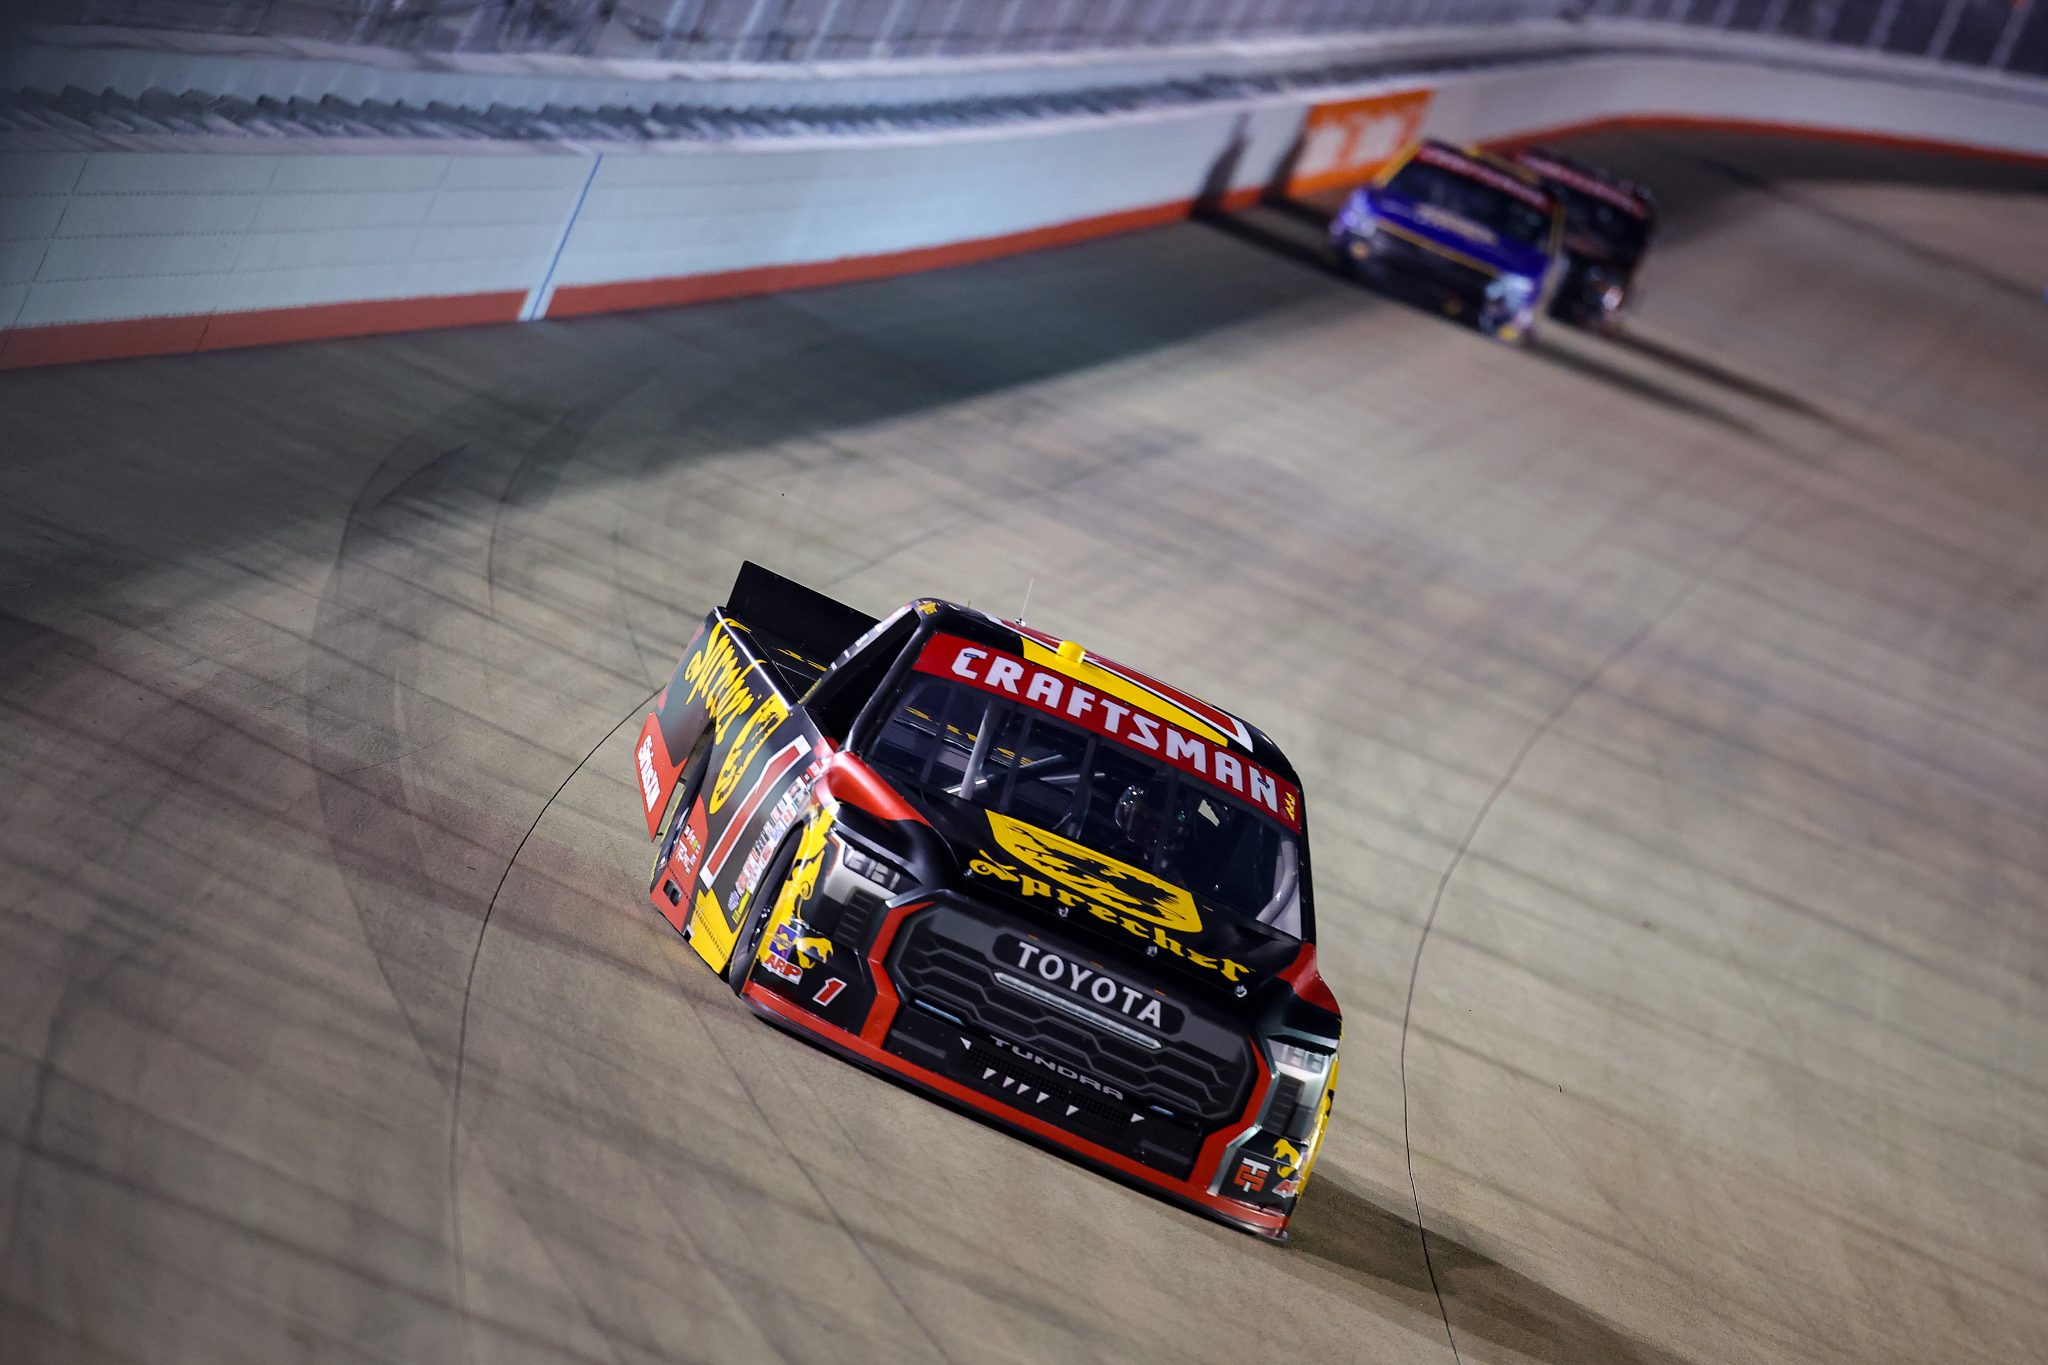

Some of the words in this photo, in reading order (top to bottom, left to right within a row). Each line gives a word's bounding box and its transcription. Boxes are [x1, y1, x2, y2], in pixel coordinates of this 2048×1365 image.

[951, 647, 1279, 813] CRAFTSMAN
[969, 849, 1250, 983] Sprecher
[764, 953, 803, 977] ARP
[812, 977, 847, 1007] 1
[1017, 942, 1163, 1029] TOYOTA
[991, 1035, 1124, 1100] TUNDRA
